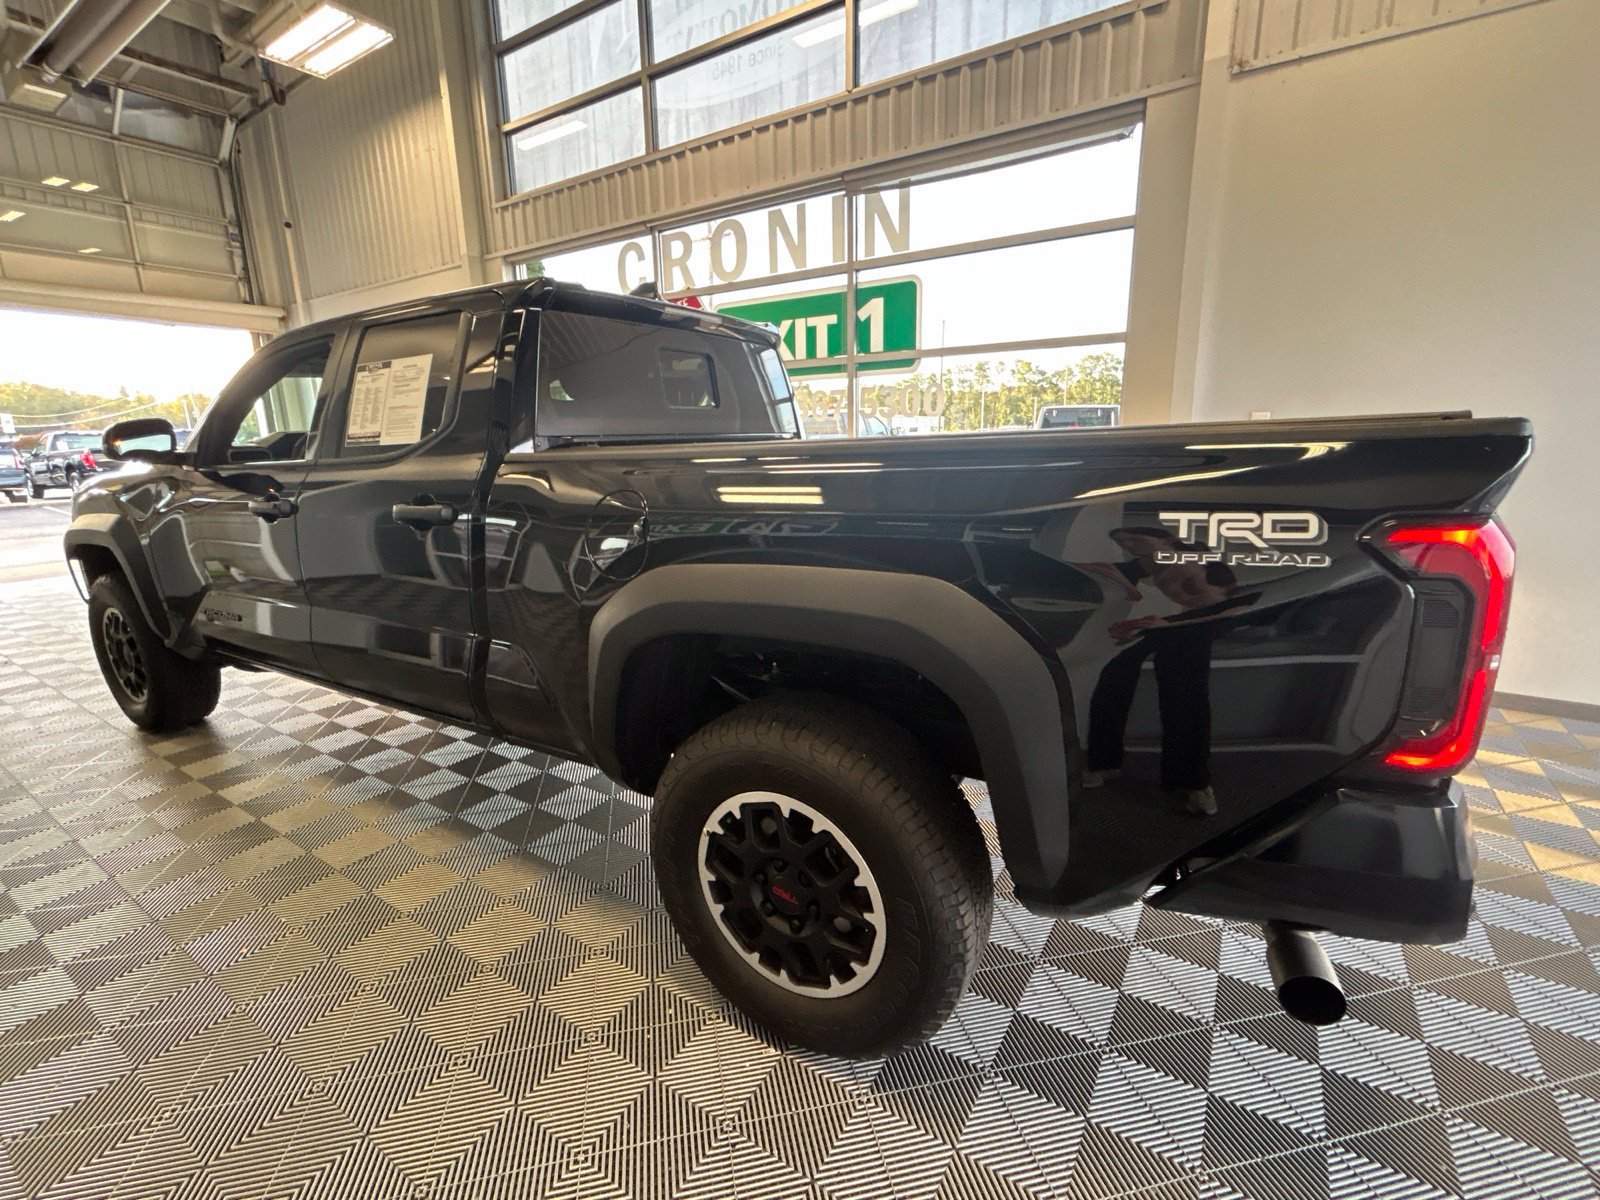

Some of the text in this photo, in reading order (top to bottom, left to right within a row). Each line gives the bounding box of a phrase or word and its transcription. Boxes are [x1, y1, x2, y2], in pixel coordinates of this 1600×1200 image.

[617, 187, 911, 295] CRONIN
[777, 296, 885, 361] XIT 1
[859, 383, 945, 419] 5300
[1158, 511, 1328, 554] TRD
[1154, 551, 1332, 568] OFF ROAD
